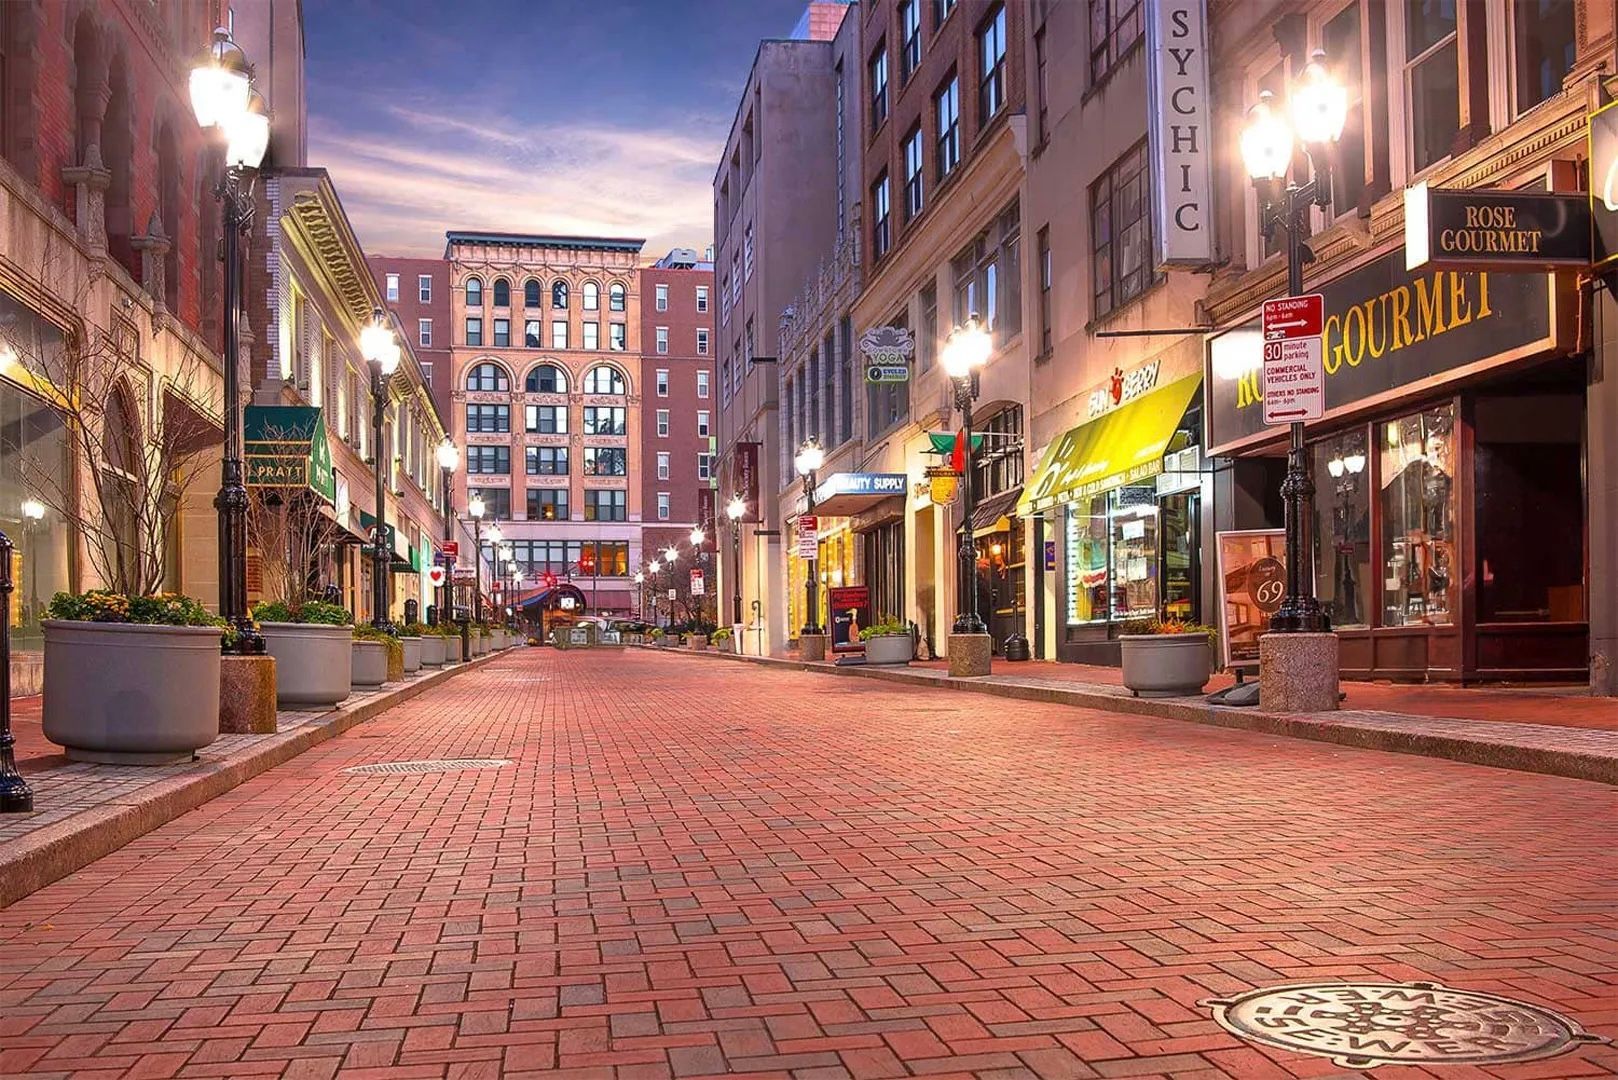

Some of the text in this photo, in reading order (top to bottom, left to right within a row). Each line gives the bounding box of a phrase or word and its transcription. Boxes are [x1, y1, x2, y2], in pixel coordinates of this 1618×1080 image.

[1168, 10, 1200, 231] SYCHIC
[1465, 206, 1517, 228] ROSE
[1440, 229, 1542, 253] GOURMET
[1265, 300, 1309, 312] NO STANDING
[1322, 271, 1492, 375] GOURMET
[1265, 343, 1281, 361] 30
[1284, 342, 1307, 351] minute
[872, 352, 904, 363] YOGA
[1284, 350, 1309, 361] parking
[1266, 364, 1307, 375] COMMERCIAL
[1267, 372, 1316, 384] VEHICLES ONLY
[1267, 386, 1320, 398] OTHERS NO STANDING
[258, 465, 303, 477] PRATT
[842, 477, 904, 489] AUTY SUPPLY
[1256, 580, 1283, 604] 69
[1255, 1016, 1529, 1056] SEWER
